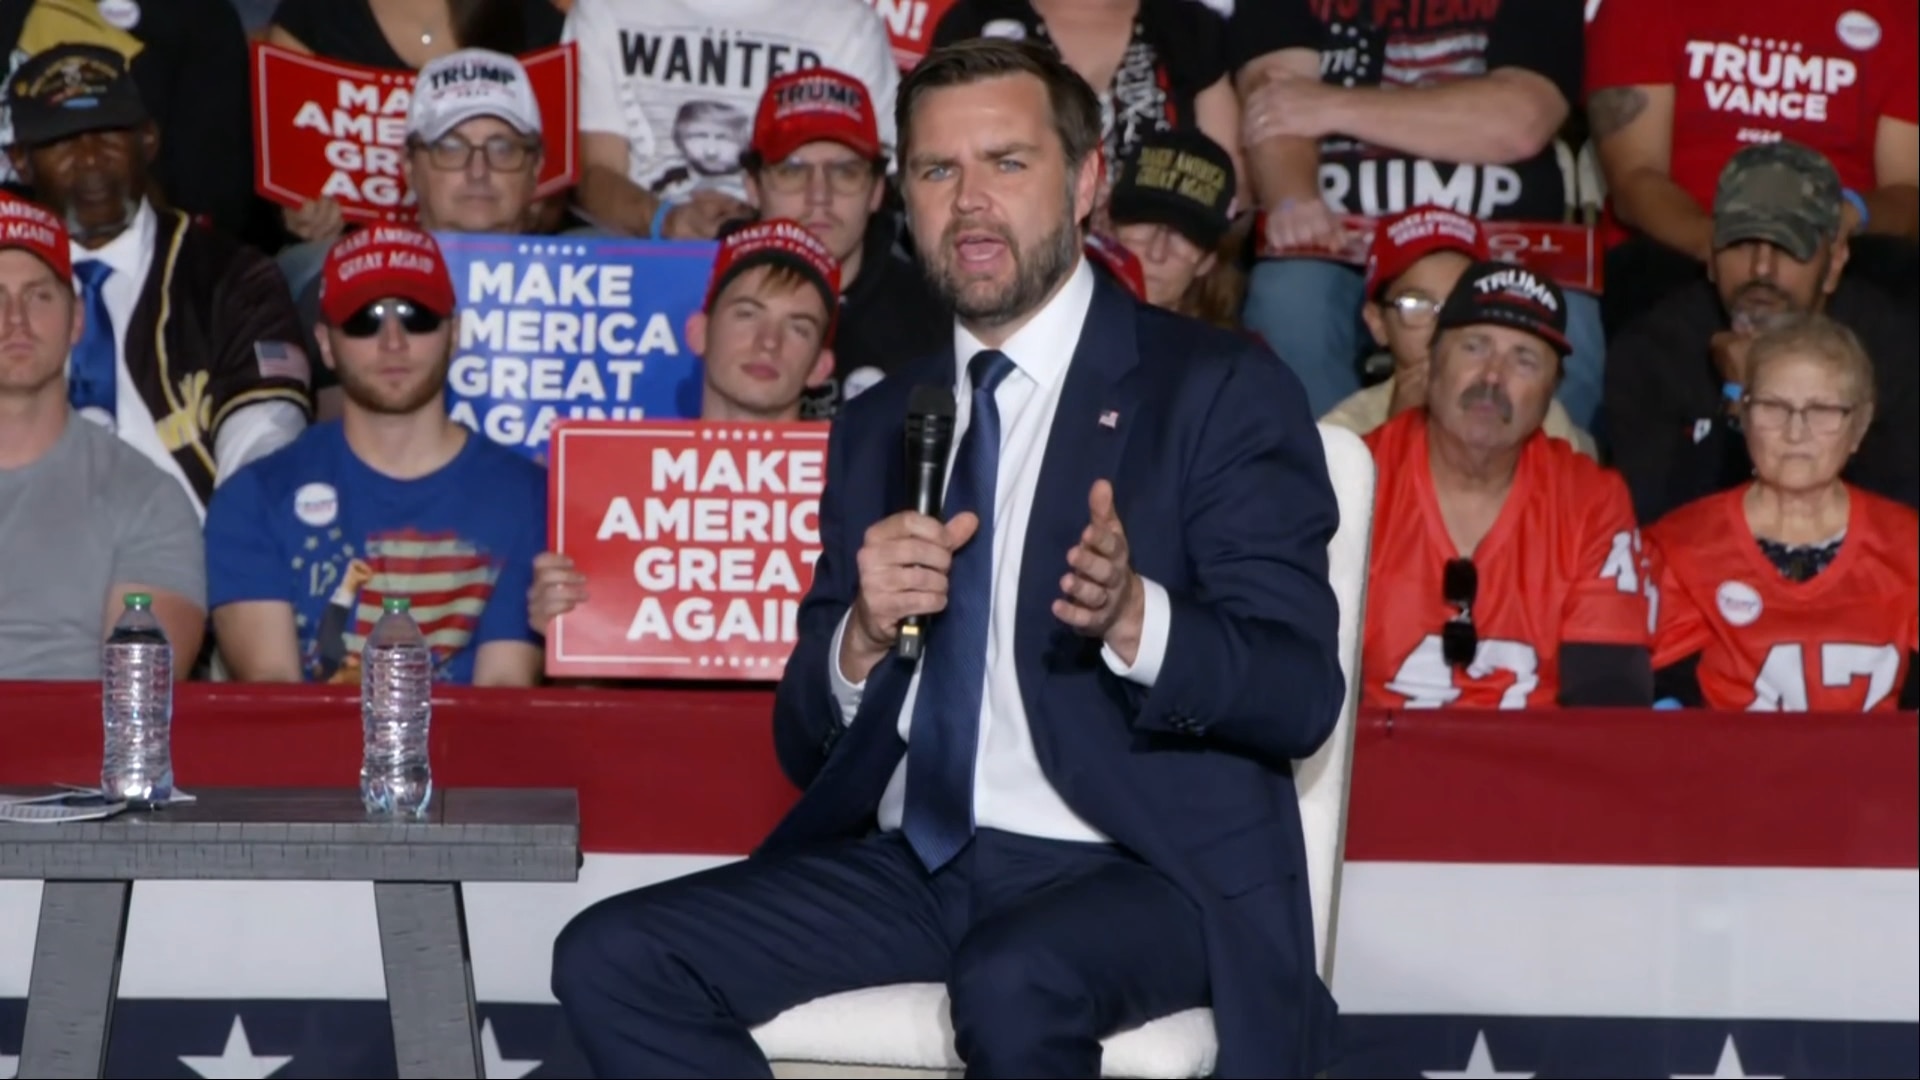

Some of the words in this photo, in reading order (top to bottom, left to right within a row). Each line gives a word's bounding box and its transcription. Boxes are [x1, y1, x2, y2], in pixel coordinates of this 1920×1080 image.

[431, 61, 516, 91] TRUMP
[1319, 47, 1357, 75] 776
[1685, 40, 1856, 94] TRUMP
[337, 79, 413, 115] MA
[1704, 80, 1828, 122] VANCE
[1319, 158, 1522, 221] RUMP
[334, 229, 369, 260] MAKE
[373, 227, 436, 253] AMERICA
[338, 251, 383, 281] GREAT
[388, 251, 434, 275] AGAIN
[468, 261, 633, 307] MAKE
[1473, 268, 1558, 312] TRUMP
[459, 308, 679, 356] MERICA
[448, 355, 644, 402] GREAT
[652, 448, 824, 494] MAKE
[596, 496, 820, 543] AMERIC
[626, 597, 798, 643] AGAI
[1745, 642, 1899, 712] 47
